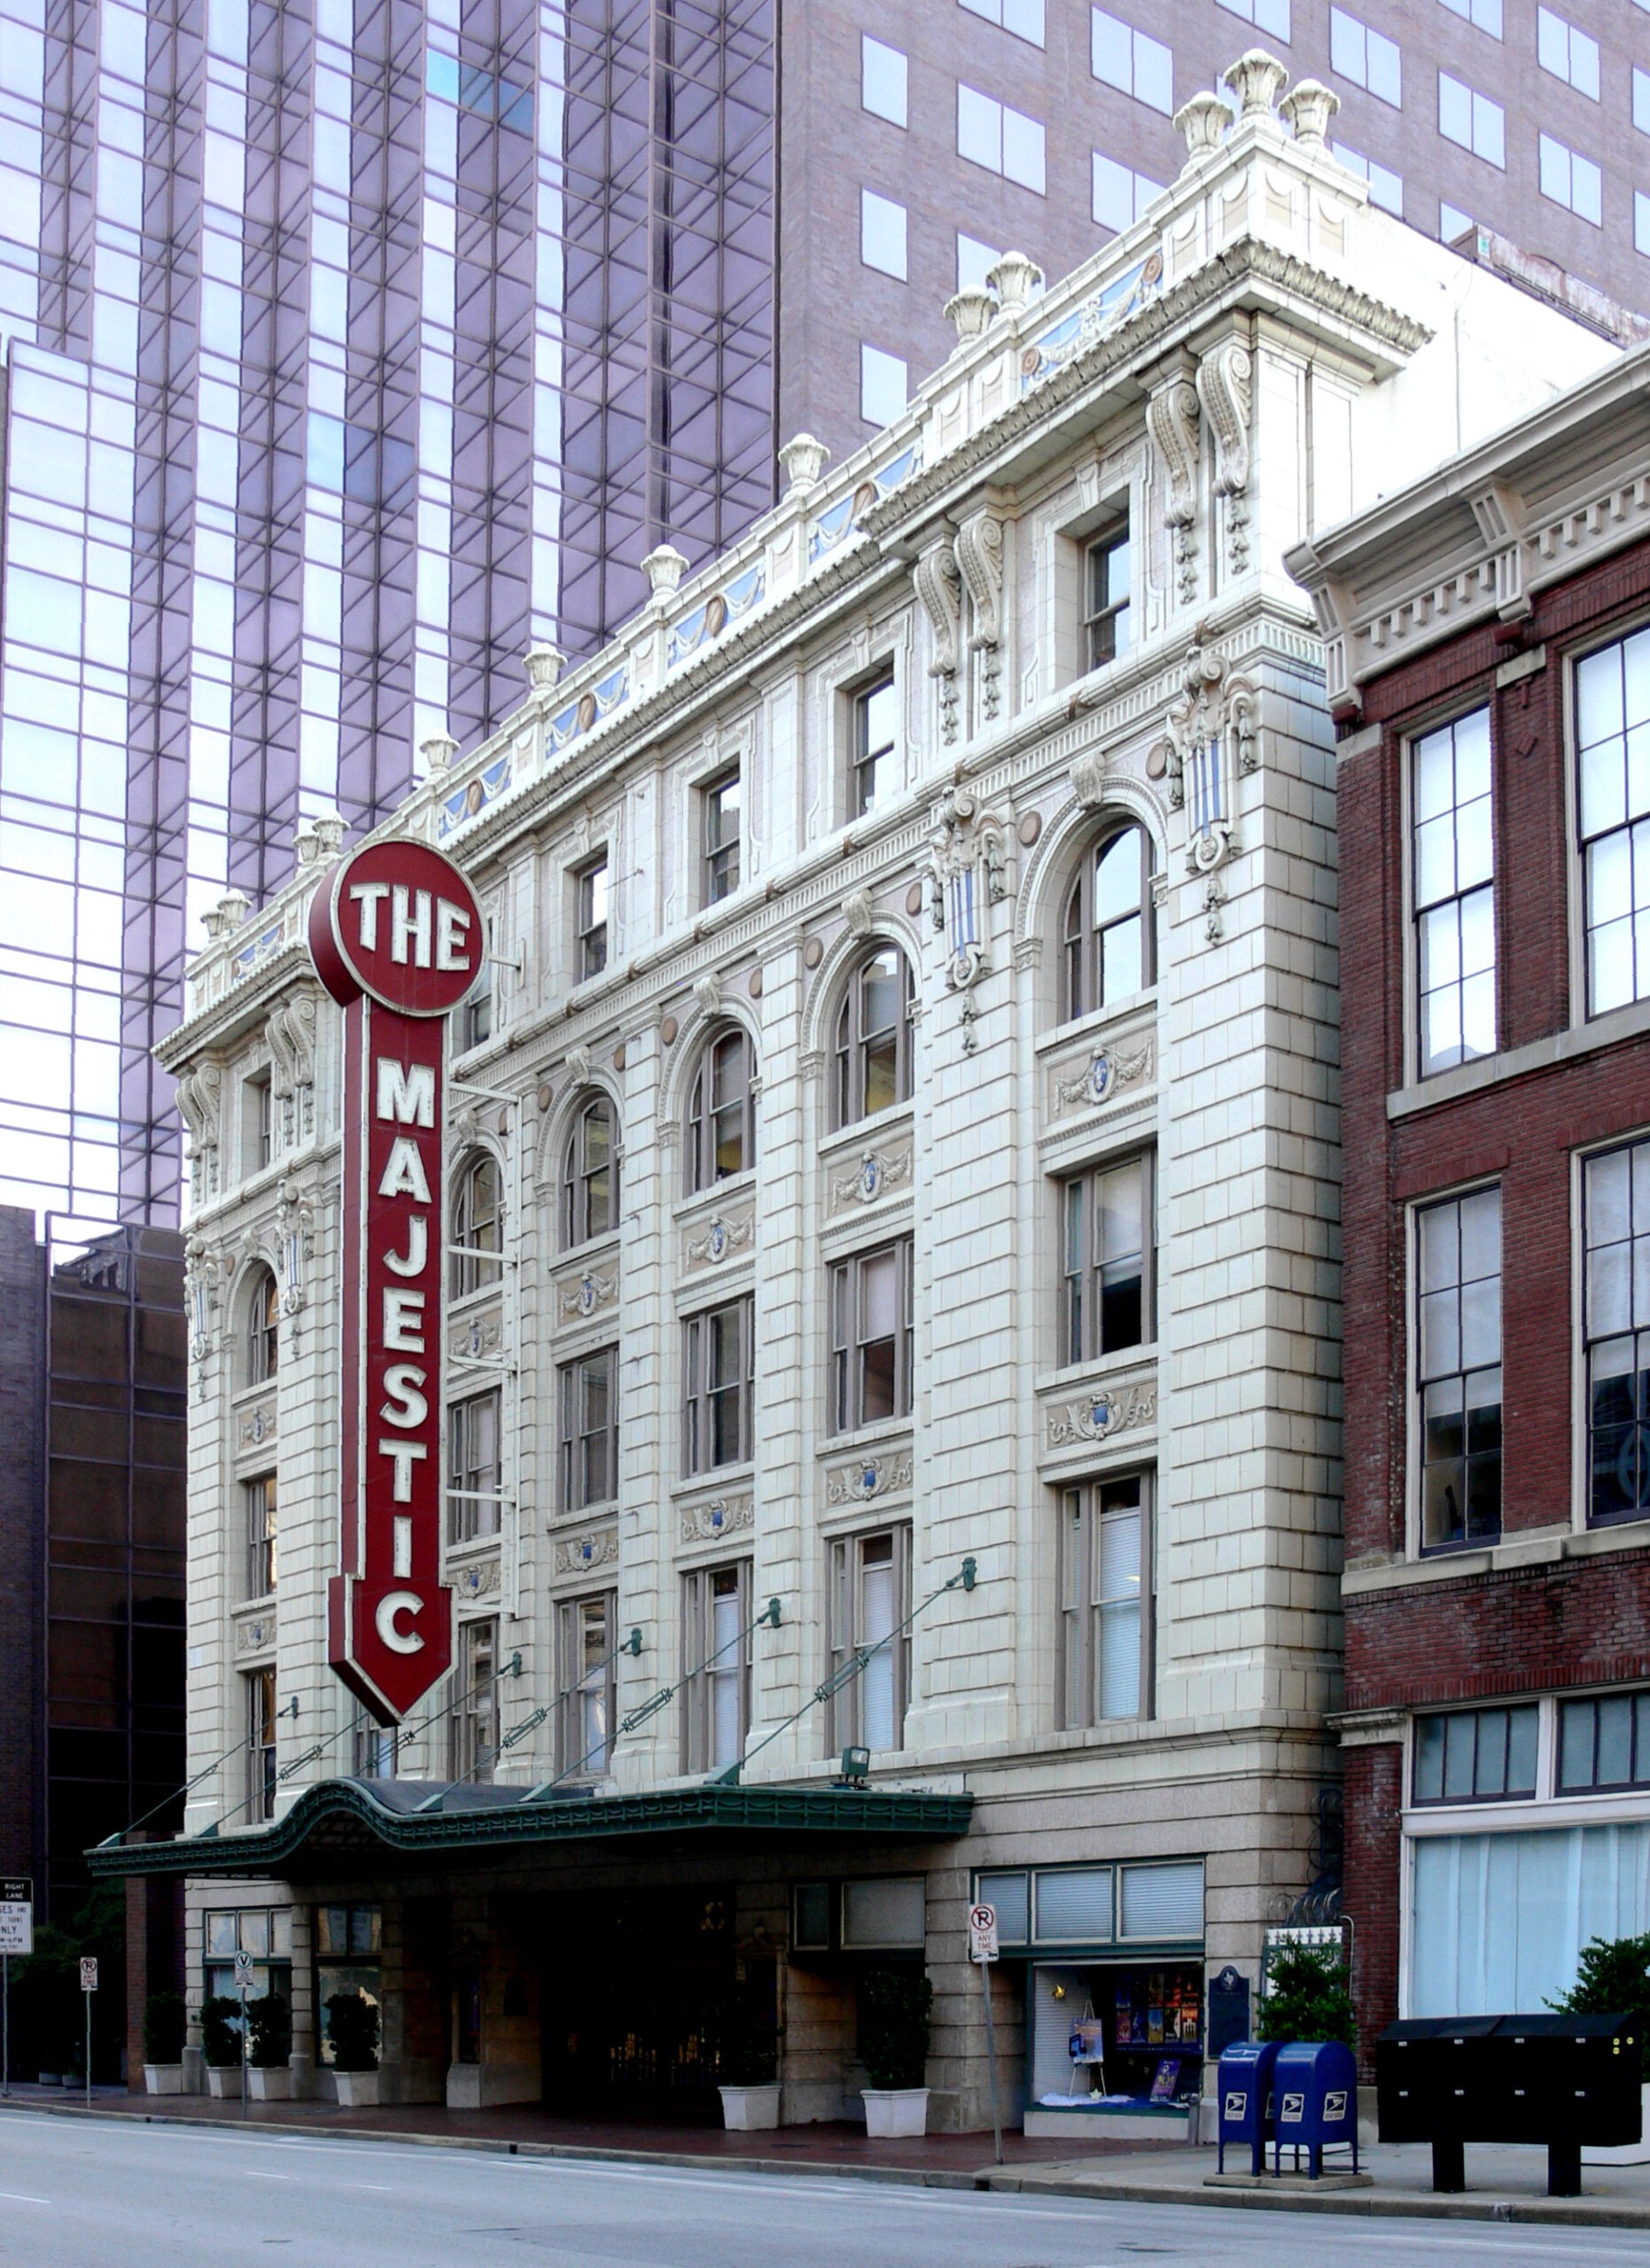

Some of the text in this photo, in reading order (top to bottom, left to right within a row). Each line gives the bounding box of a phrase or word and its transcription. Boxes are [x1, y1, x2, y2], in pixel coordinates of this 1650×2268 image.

[349, 882, 471, 971] THE
[376, 1056, 435, 1655] MAJESTIC
[240, 1955, 248, 1966] V
